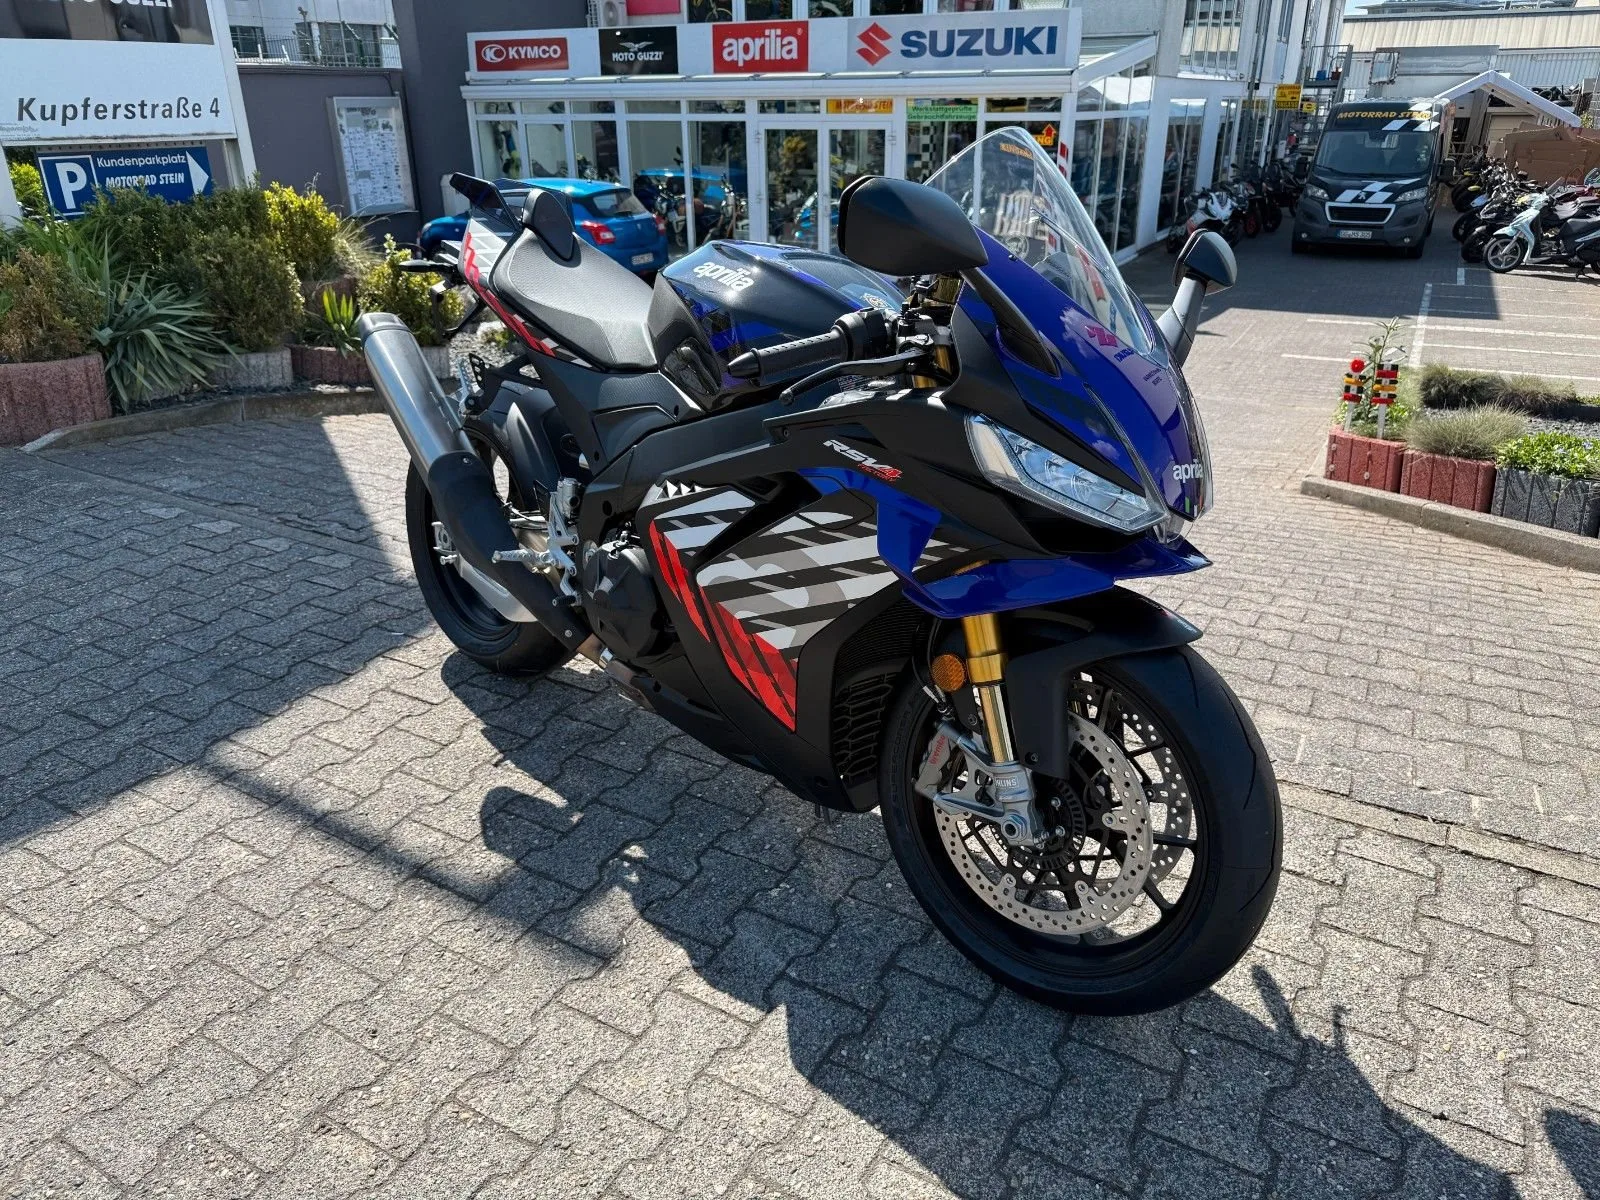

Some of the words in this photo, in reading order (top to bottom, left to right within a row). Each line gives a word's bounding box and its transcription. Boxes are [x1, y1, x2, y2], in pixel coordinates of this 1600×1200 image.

[508, 45, 562, 60] KYMCO
[722, 29, 799, 67] aprilia
[900, 26, 1058, 59] SUZUKI
[612, 52, 636, 62] MOTO
[636, 51, 664, 61] GUZZI
[17, 97, 202, 126] Kupferstraße
[209, 97, 220, 118] 4
[1337, 111, 1397, 119] MOTORRAD
[96, 153, 187, 168] Kundenparkplatz
[55, 162, 88, 210] P
[159, 172, 185, 185] STEIN
[692, 261, 756, 292] aprilia
